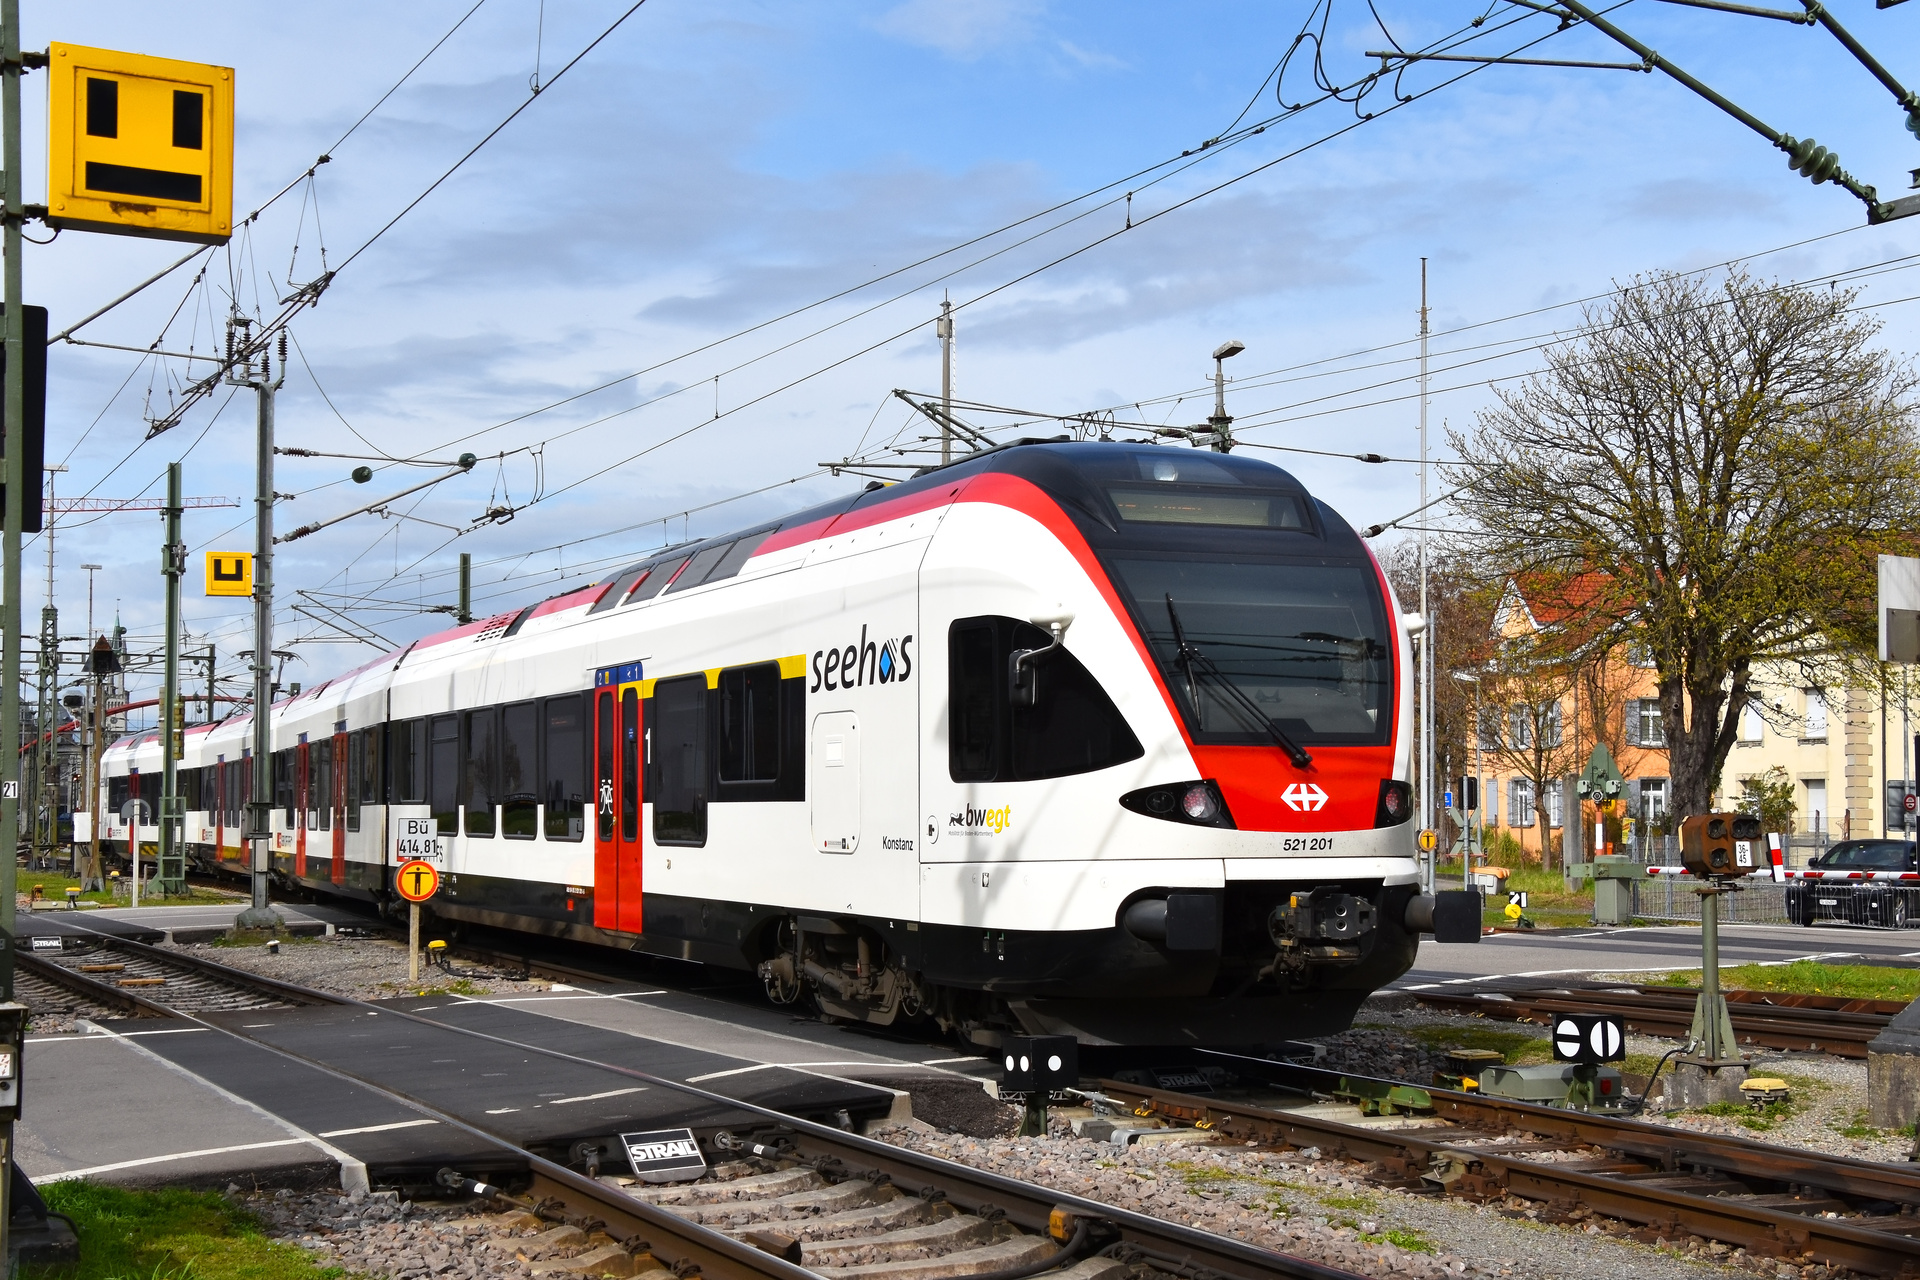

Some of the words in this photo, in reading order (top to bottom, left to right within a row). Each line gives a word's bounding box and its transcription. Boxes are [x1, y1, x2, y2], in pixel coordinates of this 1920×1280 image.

[810, 623, 913, 694] seehas
[645, 727, 651, 765] 1
[3, 782, 16, 798] 21
[965, 802, 1011, 834] bwegt
[408, 820, 428, 835] Bü
[400, 839, 437, 855] 414,81
[882, 835, 914, 851] Konstanz
[1283, 838, 1307, 851] 521
[1310, 837, 1333, 850] 201
[1739, 854, 1747, 864] 45
[1159, 1073, 1208, 1087] STRAIL
[630, 1140, 699, 1161] STRAIL
